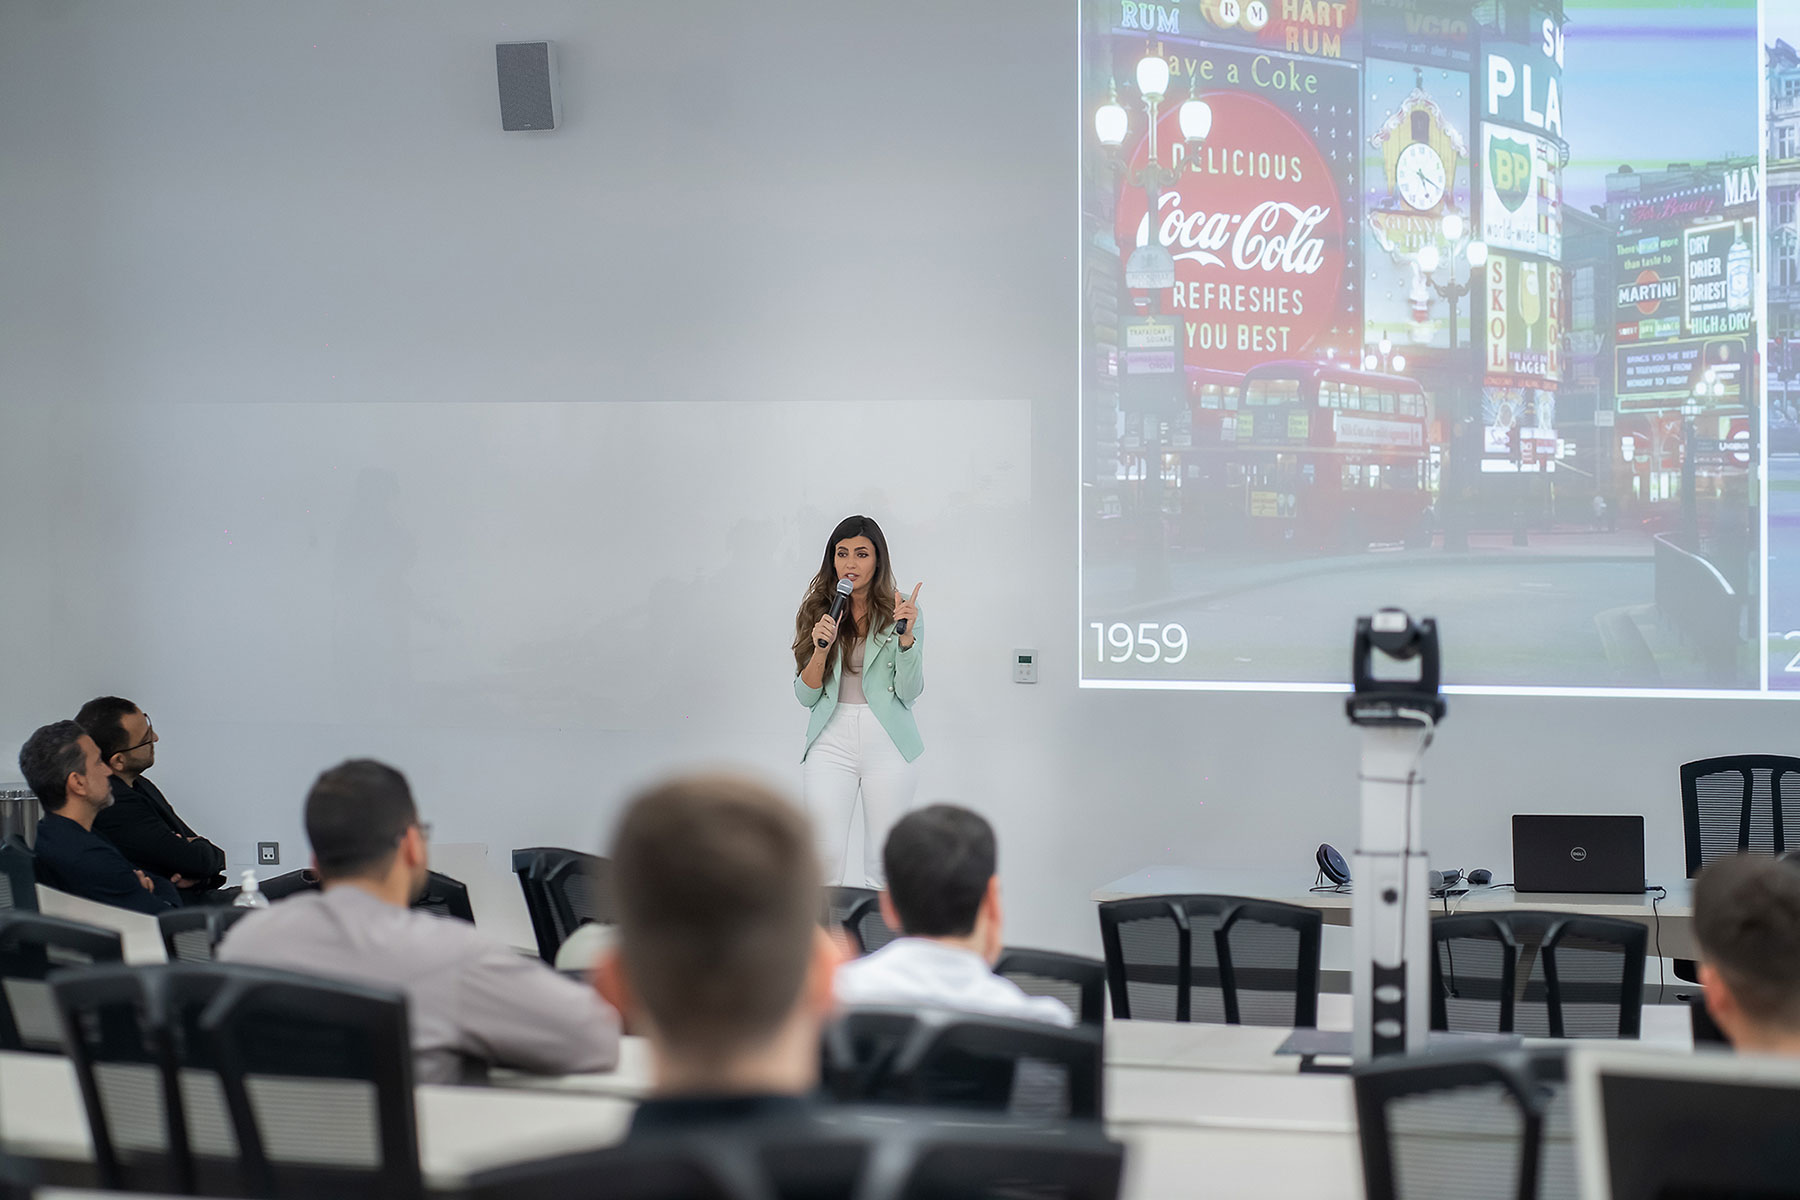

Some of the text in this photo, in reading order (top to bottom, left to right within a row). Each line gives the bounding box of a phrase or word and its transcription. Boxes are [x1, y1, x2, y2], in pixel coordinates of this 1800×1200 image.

[1121, 0, 1180, 34] RUM
[1282, 0, 1347, 28] HART
[1286, 26, 1342, 58] RUM
[1145, 40, 1318, 94] ave a Coke
[1488, 54, 1562, 138] PLA
[1494, 148, 1529, 193] BP
[1136, 191, 1331, 274] Coca-Cola
[1689, 235, 1710, 255] DRY
[1690, 257, 1722, 279] DRIER
[1173, 281, 1304, 315] REFRESHES
[1618, 281, 1677, 304] MARTINI
[1690, 281, 1727, 303] DRIEST
[1491, 261, 1506, 367] SKOL
[1185, 322, 1291, 352] YOU BEST
[1515, 361, 1547, 375] LAGER
[1090, 622, 1188, 664] 1959
